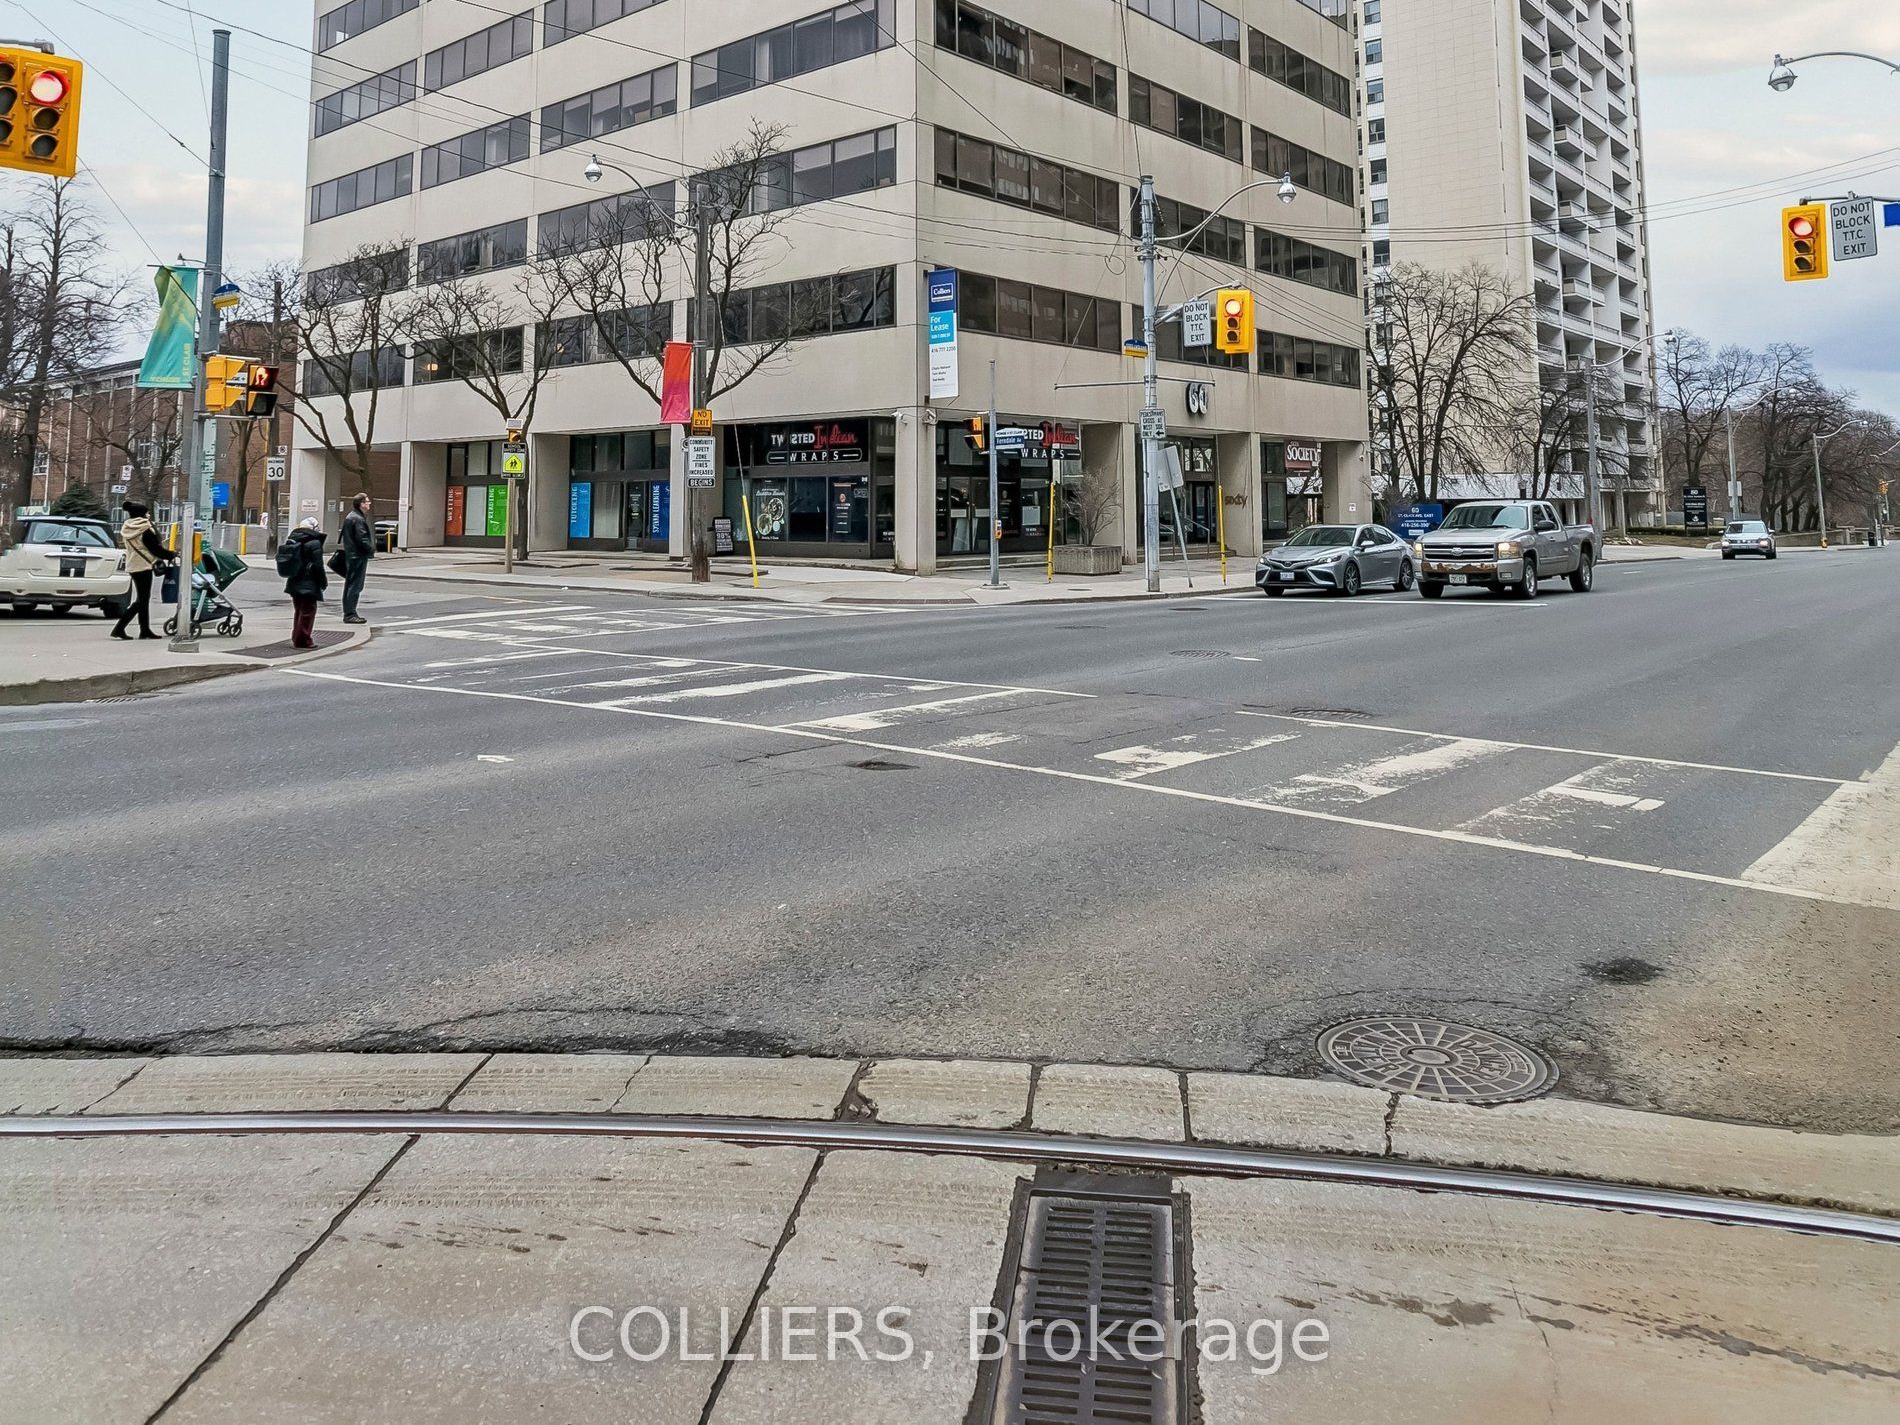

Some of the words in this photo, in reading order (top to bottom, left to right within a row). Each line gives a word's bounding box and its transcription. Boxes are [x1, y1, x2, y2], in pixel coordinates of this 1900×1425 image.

[1833, 206, 1847, 217] DO
[1850, 202, 1871, 214] NOT
[1835, 215, 1871, 229] BLOCK
[1843, 243, 1866, 255] EXIT
[1184, 305, 1194, 313] DO
[1195, 303, 1208, 311] NOT
[930, 316, 941, 324] For
[1186, 313, 1208, 322] BLOCK
[930, 324, 949, 332] Lease
[1190, 334, 1205, 342] EXIT
[789, 451, 839, 461] WRAPS
[1020, 448, 1065, 459] WRAPS
[1287, 444, 1318, 461] SOCIETY
[268, 466, 284, 478] 30
[570, 486, 578, 523] TUTORING
